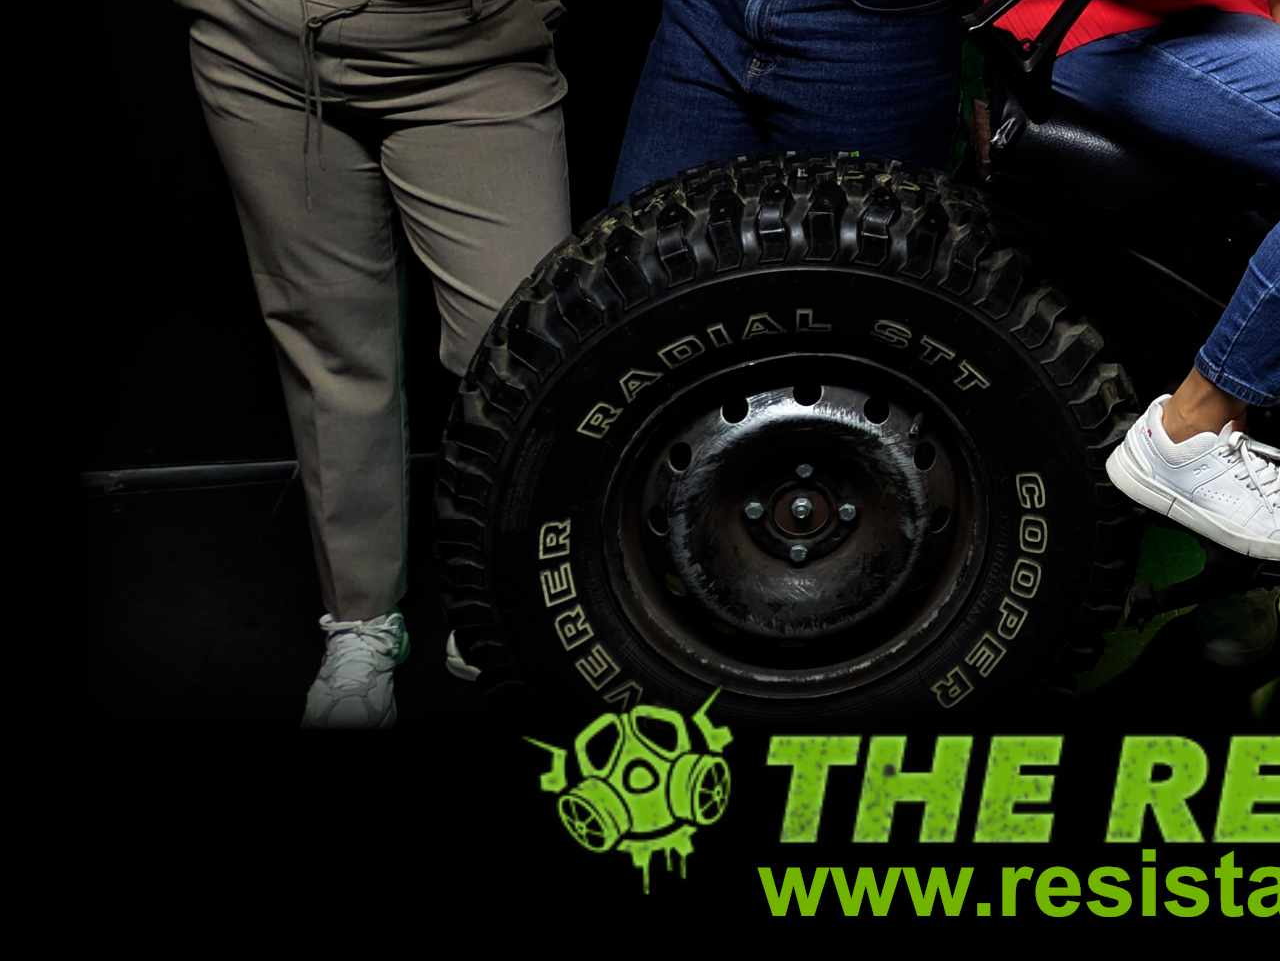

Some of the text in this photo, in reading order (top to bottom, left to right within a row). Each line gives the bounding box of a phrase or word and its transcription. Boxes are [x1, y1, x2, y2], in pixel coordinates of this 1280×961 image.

[576, 308, 992, 440] RADIAL STT
[929, 471, 1049, 709] COOPER
